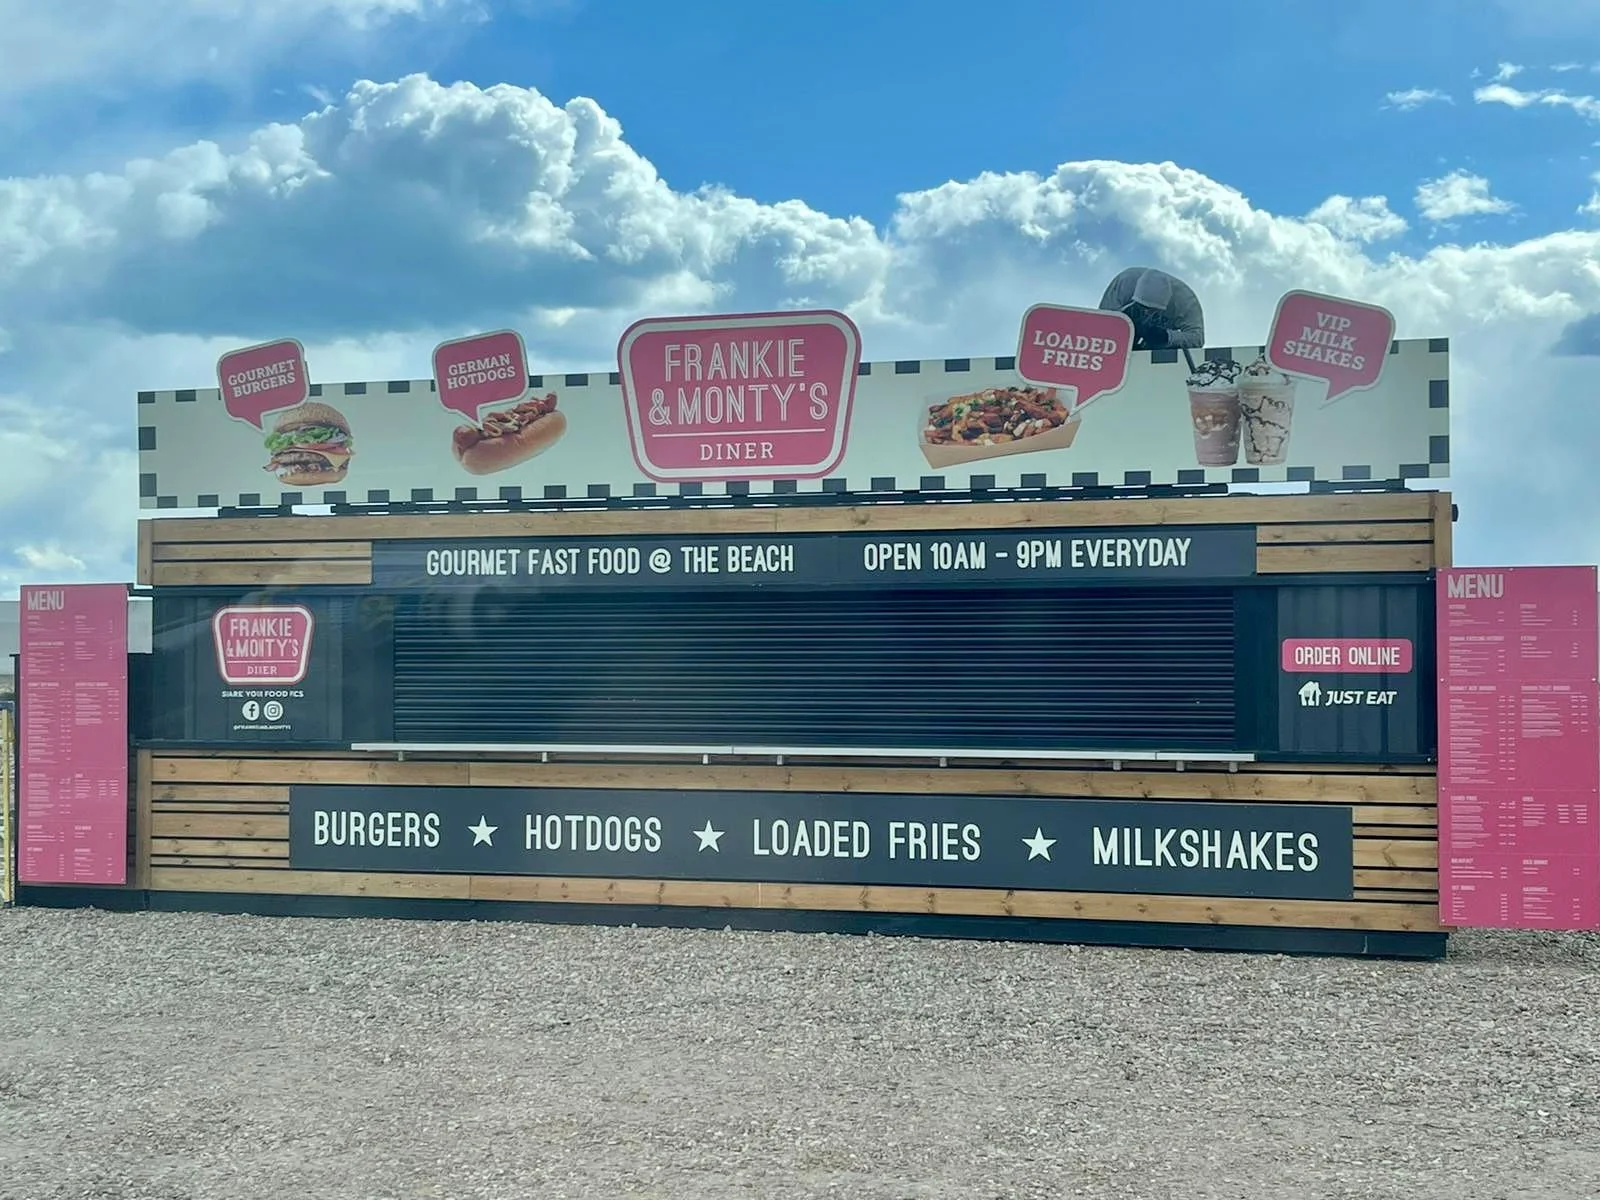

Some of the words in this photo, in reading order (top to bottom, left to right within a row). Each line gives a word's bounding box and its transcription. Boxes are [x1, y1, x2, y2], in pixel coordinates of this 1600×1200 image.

[1317, 311, 1351, 332] VIP
[1033, 330, 1117, 355] LOADED
[1300, 326, 1357, 351] MILK
[448, 353, 511, 376] GERMAN
[665, 338, 804, 382] FRANKIE
[1042, 349, 1103, 371] FRIES
[1283, 340, 1365, 370] SHAKES
[228, 359, 296, 386] GOURMET
[233, 372, 296, 398] BURGERS
[447, 366, 516, 389] HOTDOGS
[700, 442, 774, 460] DINER
[426, 549, 520, 575] GOURMET
[528, 548, 580, 575] FAST
[588, 548, 640, 574] FOOD
[681, 546, 720, 573] THE
[727, 545, 794, 573] BEACH
[864, 542, 921, 571] OPEN
[930, 542, 986, 570] 10AM
[1016, 540, 1062, 568] 9PM
[1071, 537, 1191, 568] EVERYDAY
[1447, 574, 1504, 599] MENU
[27, 590, 65, 611] MENU
[1295, 646, 1340, 665] ORDER
[1349, 646, 1400, 665] ONLINE
[264, 690, 288, 698] FOOD
[1325, 691, 1364, 706] JUST
[1366, 691, 1397, 704] EAT
[314, 811, 440, 848] BURGERS
[525, 814, 662, 853] HOTDOGS
[753, 819, 870, 859] LOADED
[889, 822, 981, 861] FRIES
[1093, 826, 1319, 873] MILKSHAKES
